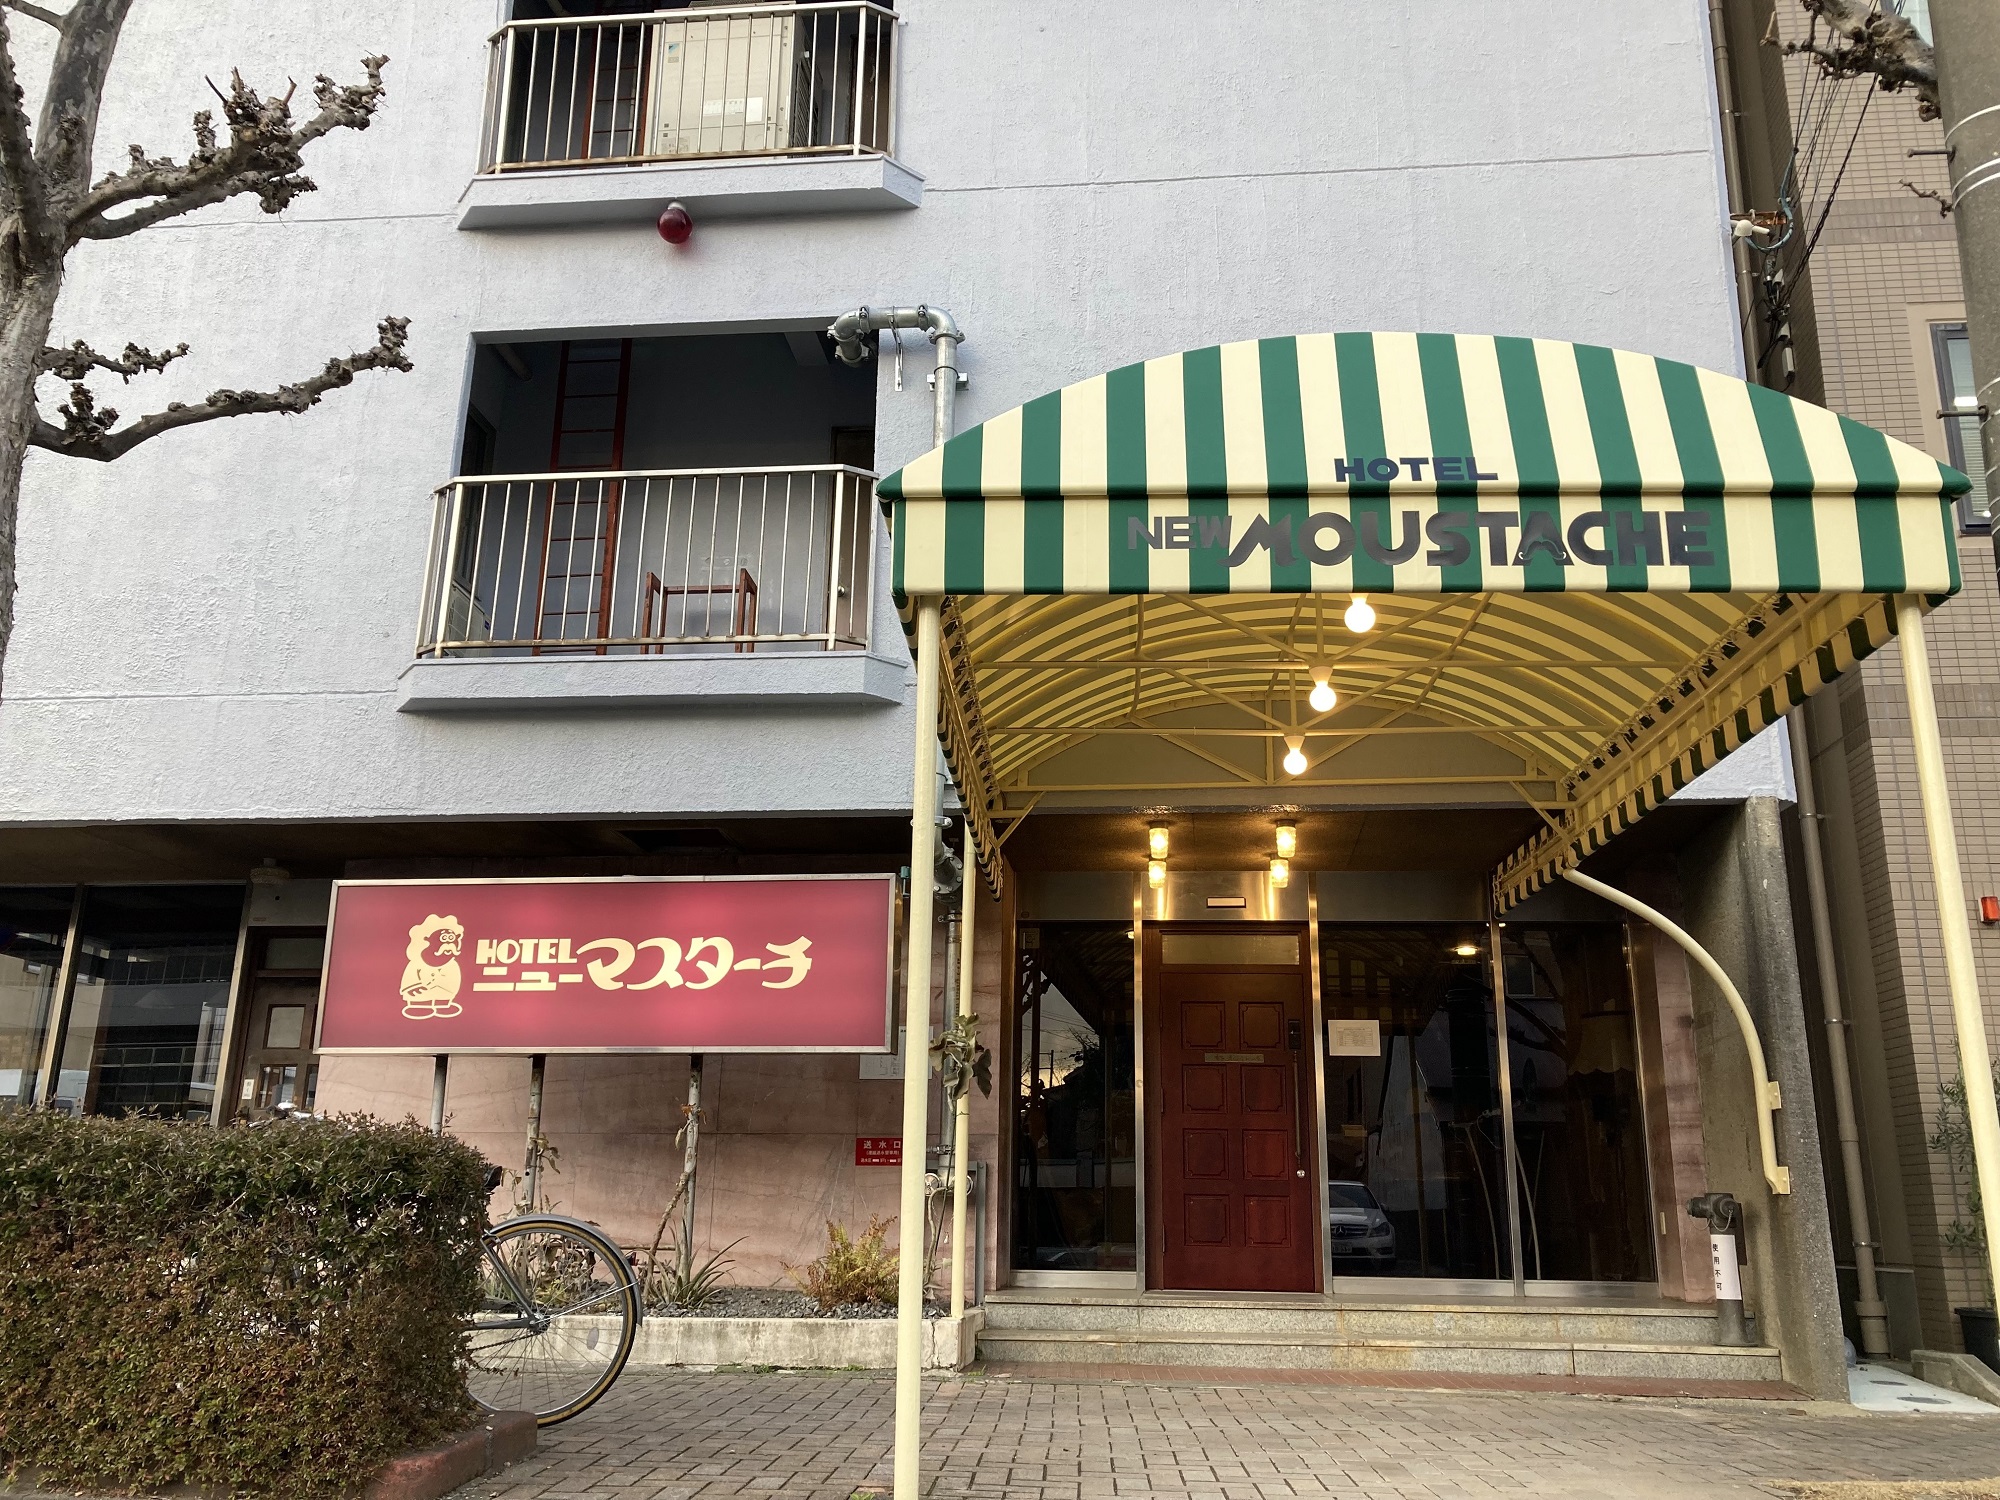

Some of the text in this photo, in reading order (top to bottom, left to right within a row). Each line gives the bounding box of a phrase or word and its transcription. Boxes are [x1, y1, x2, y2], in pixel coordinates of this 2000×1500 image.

[1334, 456, 1498, 482] HOTEL
[1127, 510, 1715, 568] NEW MOUSTACHE
[475, 938, 578, 965] HOTEL
[1712, 1243, 1722, 1291] 使用不可
